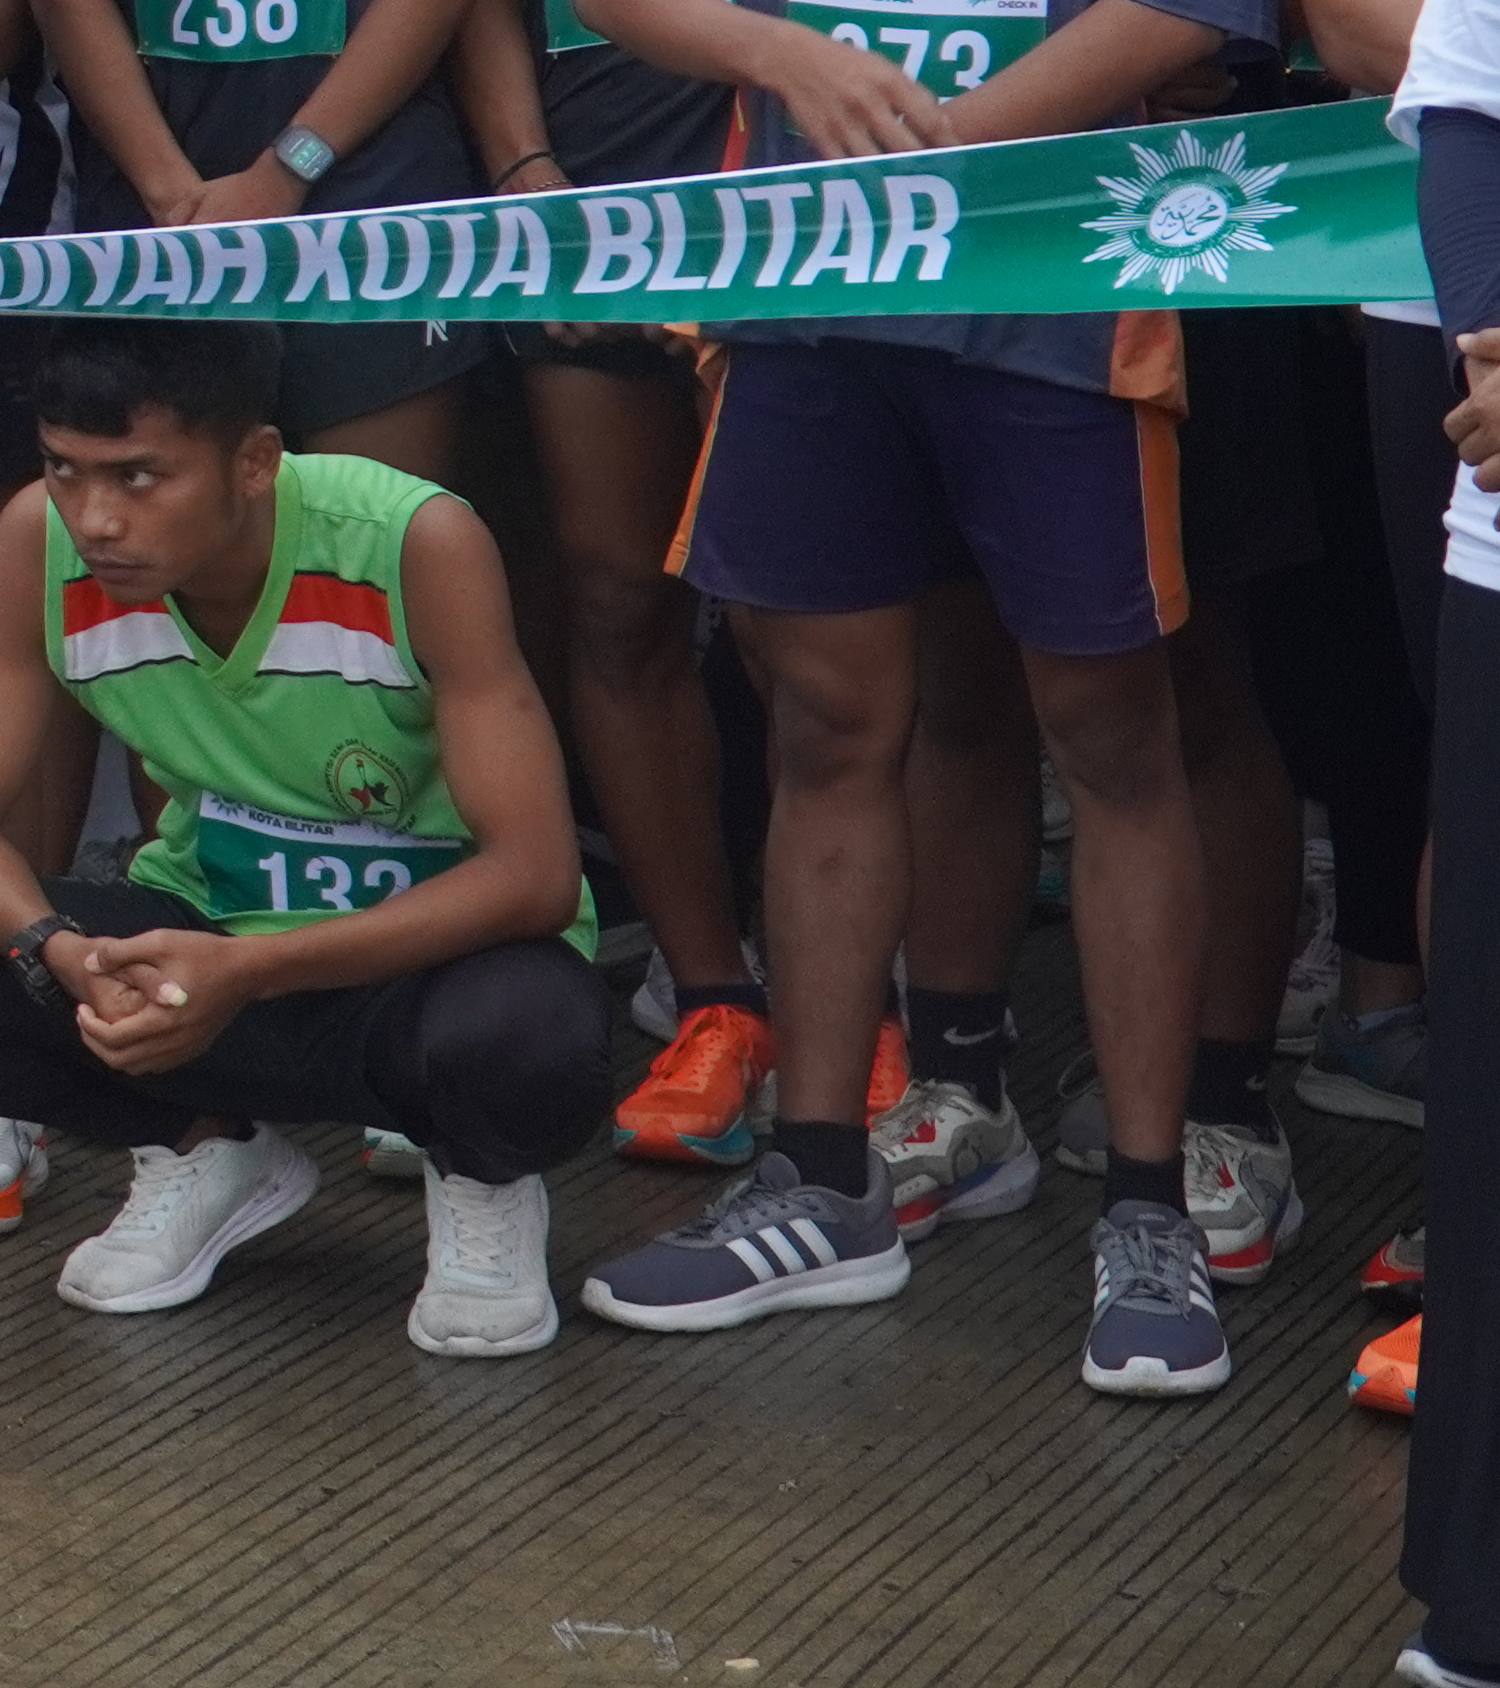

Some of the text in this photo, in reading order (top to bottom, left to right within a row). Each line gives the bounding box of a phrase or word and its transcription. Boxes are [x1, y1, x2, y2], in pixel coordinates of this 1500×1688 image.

[997, 1, 1039, 9] CHECK IN
[285, 205, 554, 304] KOTA
[576, 173, 962, 296] BLITAR
[248, 810, 335, 836] KOTA BLITAR
